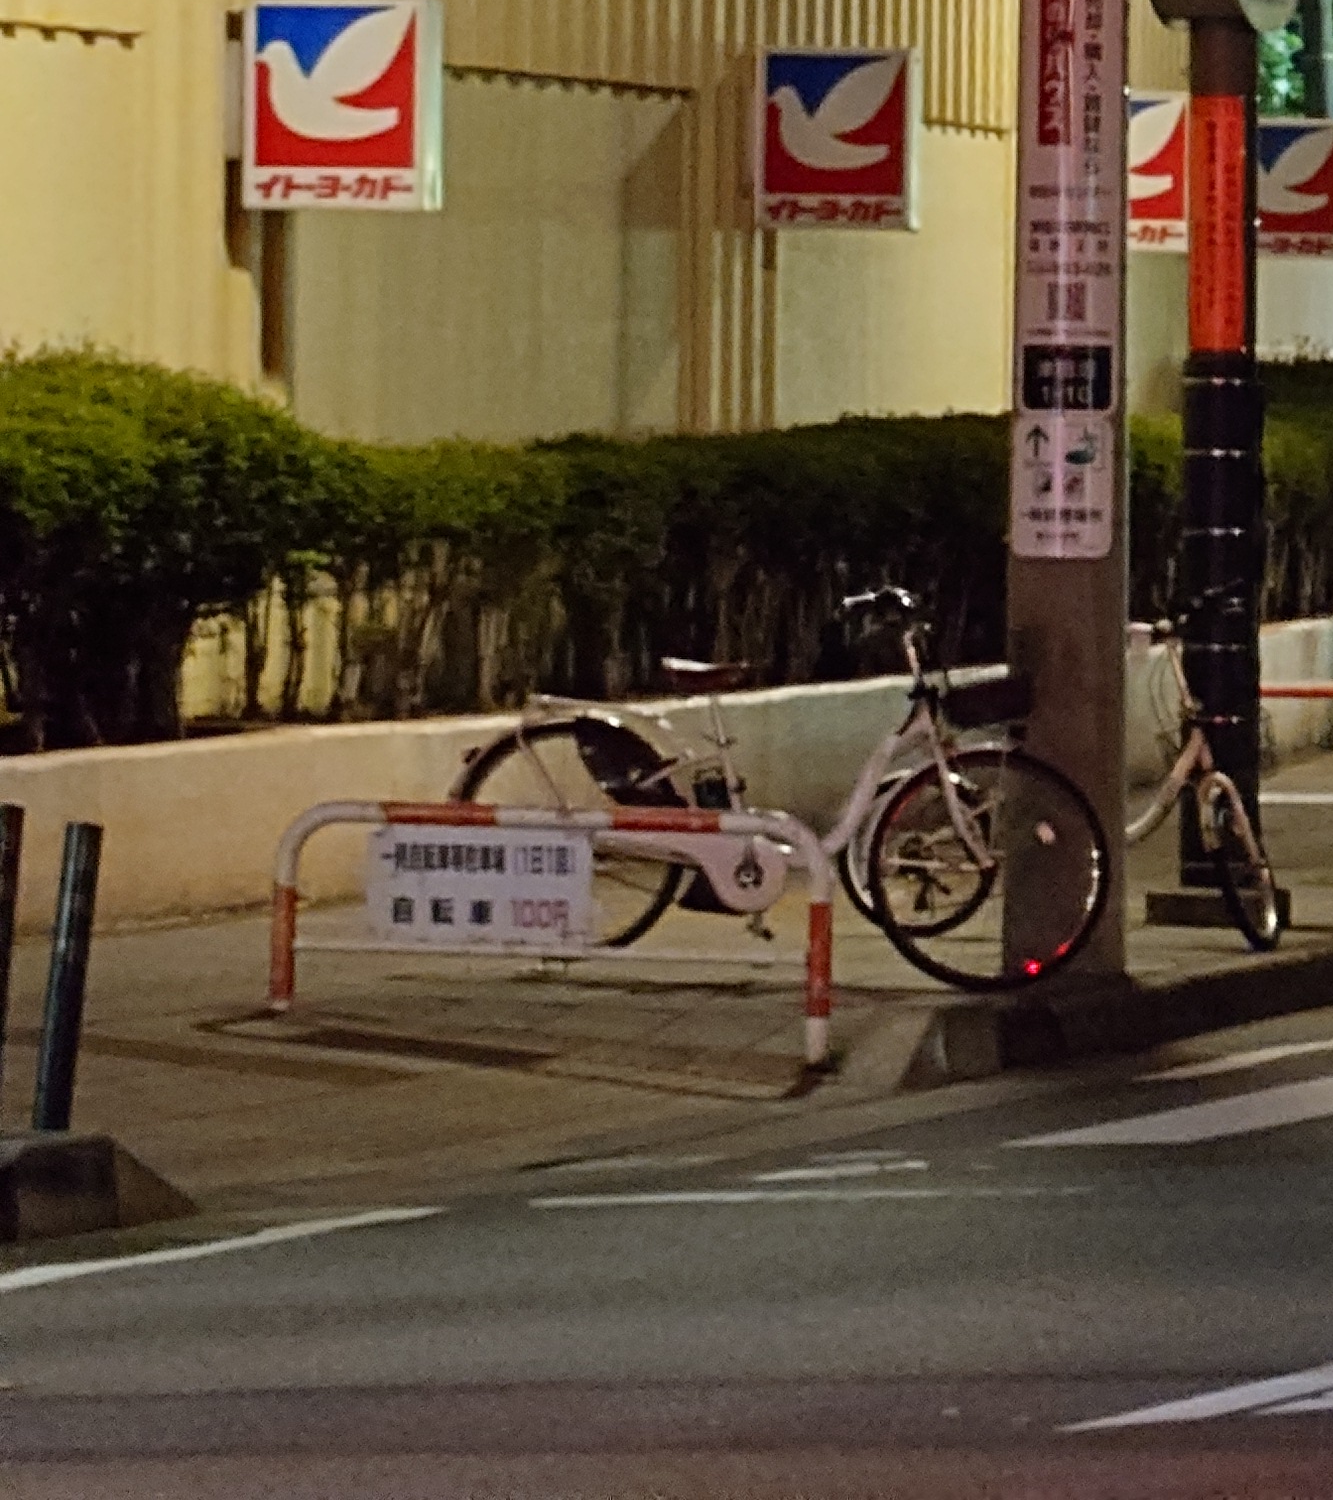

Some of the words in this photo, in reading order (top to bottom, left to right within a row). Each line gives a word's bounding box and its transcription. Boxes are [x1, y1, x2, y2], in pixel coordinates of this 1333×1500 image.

[254, 174, 413, 201] イトーヨーカドー
[766, 198, 903, 223] イトーヨーカドー
